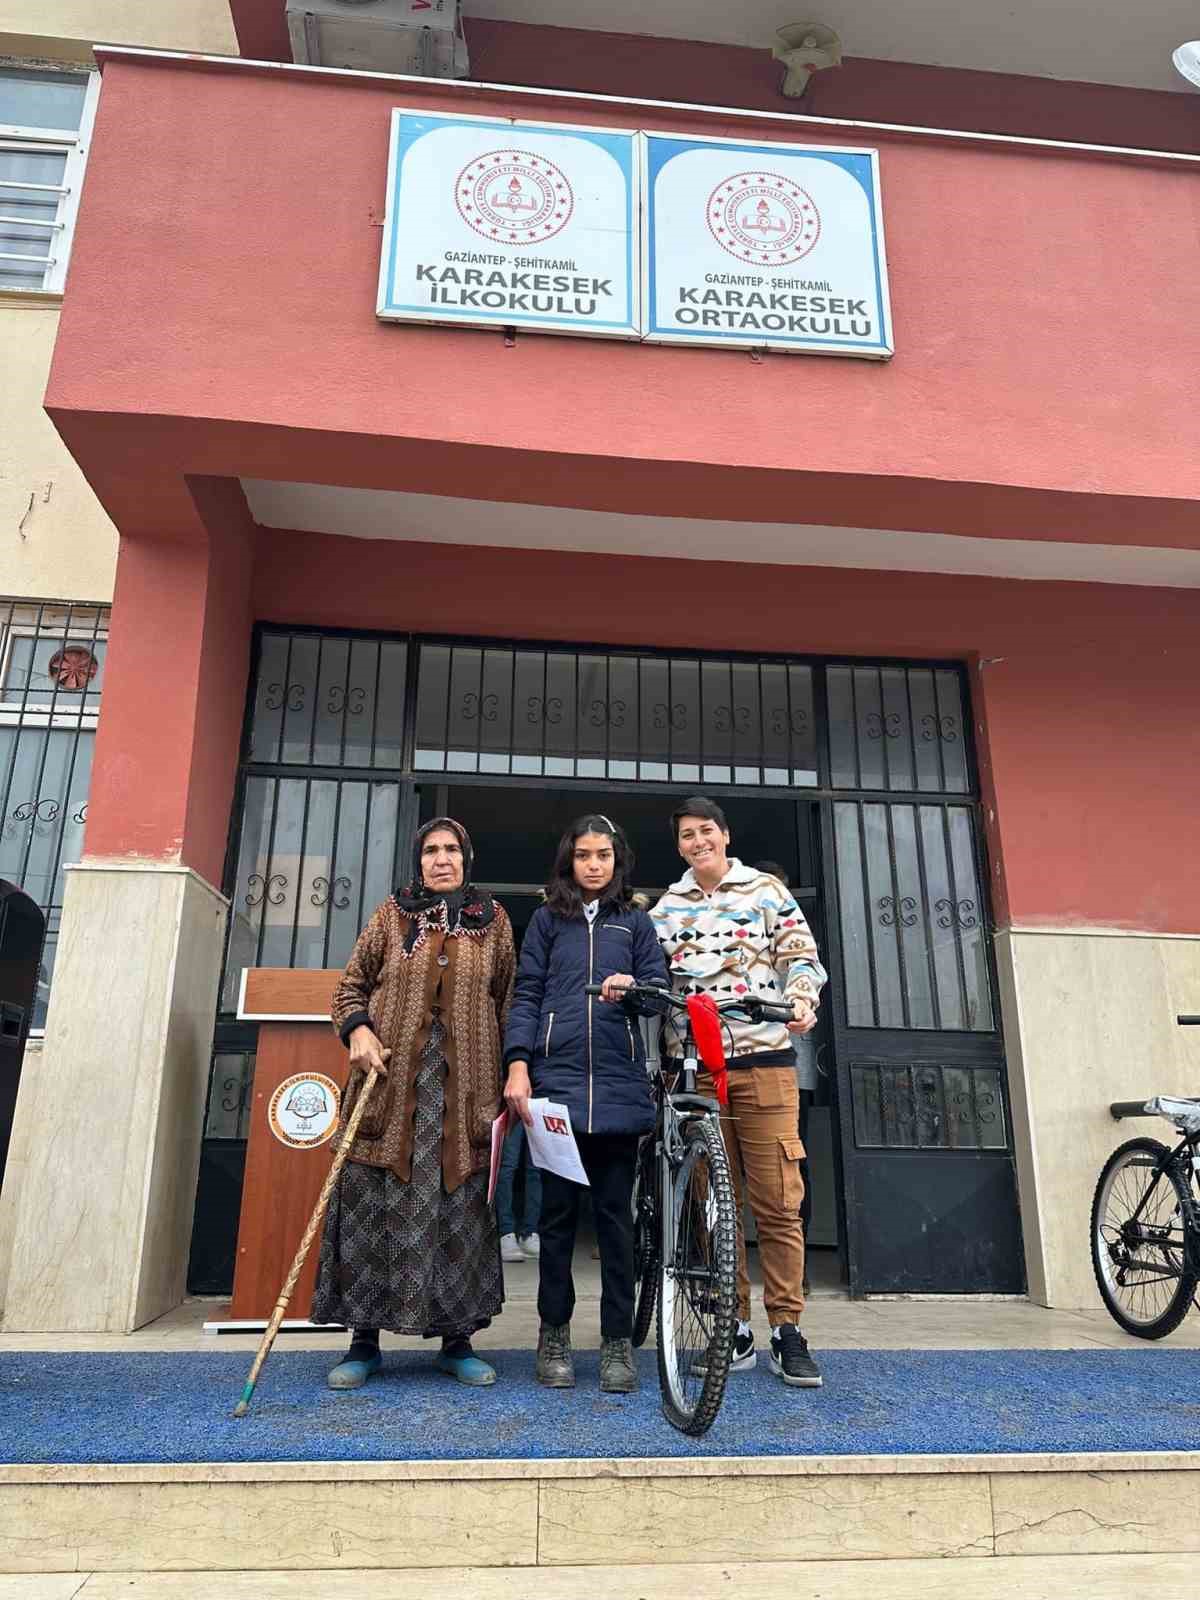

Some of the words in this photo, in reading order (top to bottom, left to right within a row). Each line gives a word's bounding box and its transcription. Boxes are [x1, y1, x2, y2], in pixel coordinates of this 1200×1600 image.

[444, 251, 506, 266] GAZİANTEP
[513, 256, 578, 272] ŞEHİTKAMİL
[416, 264, 614, 297] KARAKESEK
[704, 272, 764, 287] GAZİANTEP
[771, 278, 833, 292] ŞEHİTKAMİL
[430, 283, 597, 315] İLKOKULU
[679, 286, 868, 316] KARAKESEK
[674, 307, 872, 337] ORTAOKULU
